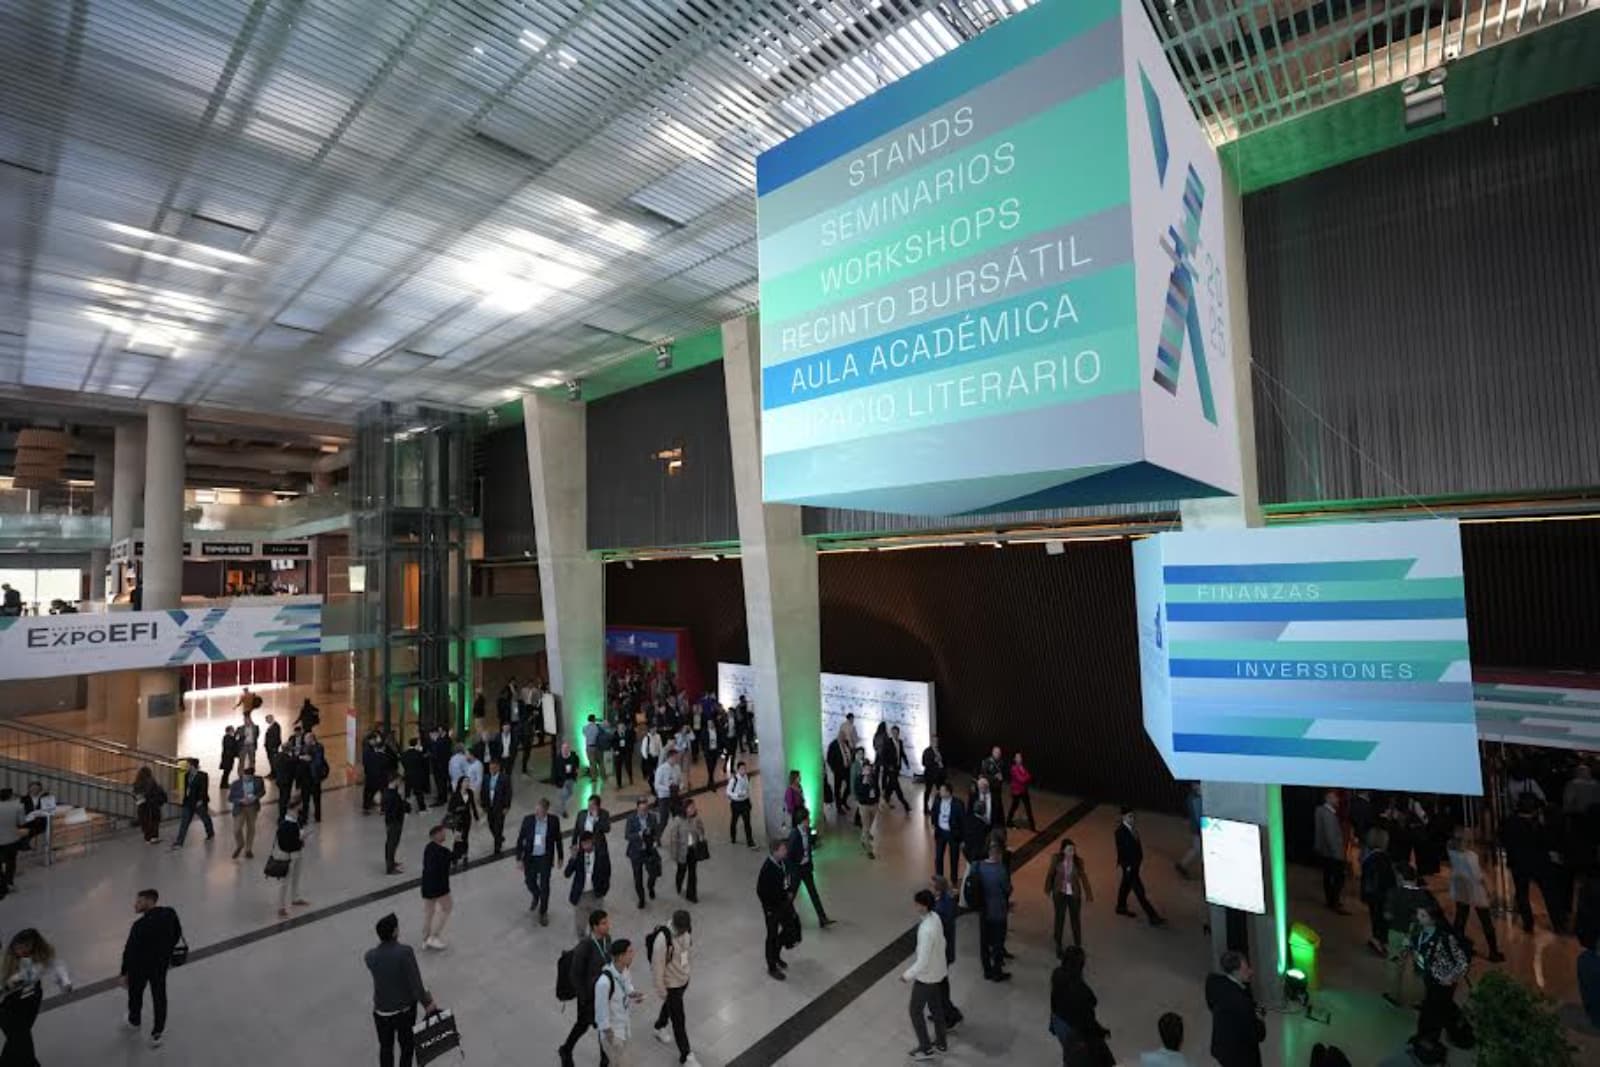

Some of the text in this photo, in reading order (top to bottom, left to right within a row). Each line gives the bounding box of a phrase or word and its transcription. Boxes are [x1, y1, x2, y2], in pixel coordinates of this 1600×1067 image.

[848, 105, 975, 187] STANDS
[820, 141, 1017, 247] SEMINARIOS
[820, 197, 1022, 296] WORKSHOPS
[781, 235, 1093, 353] RECINTO BURSÁTIL
[790, 292, 1080, 395] AULA ACADÉMICA
[907, 349, 1102, 418] LITERARIO
[1197, 583, 1321, 600] FINANZAS
[1236, 661, 1414, 679] INVERSIONES
